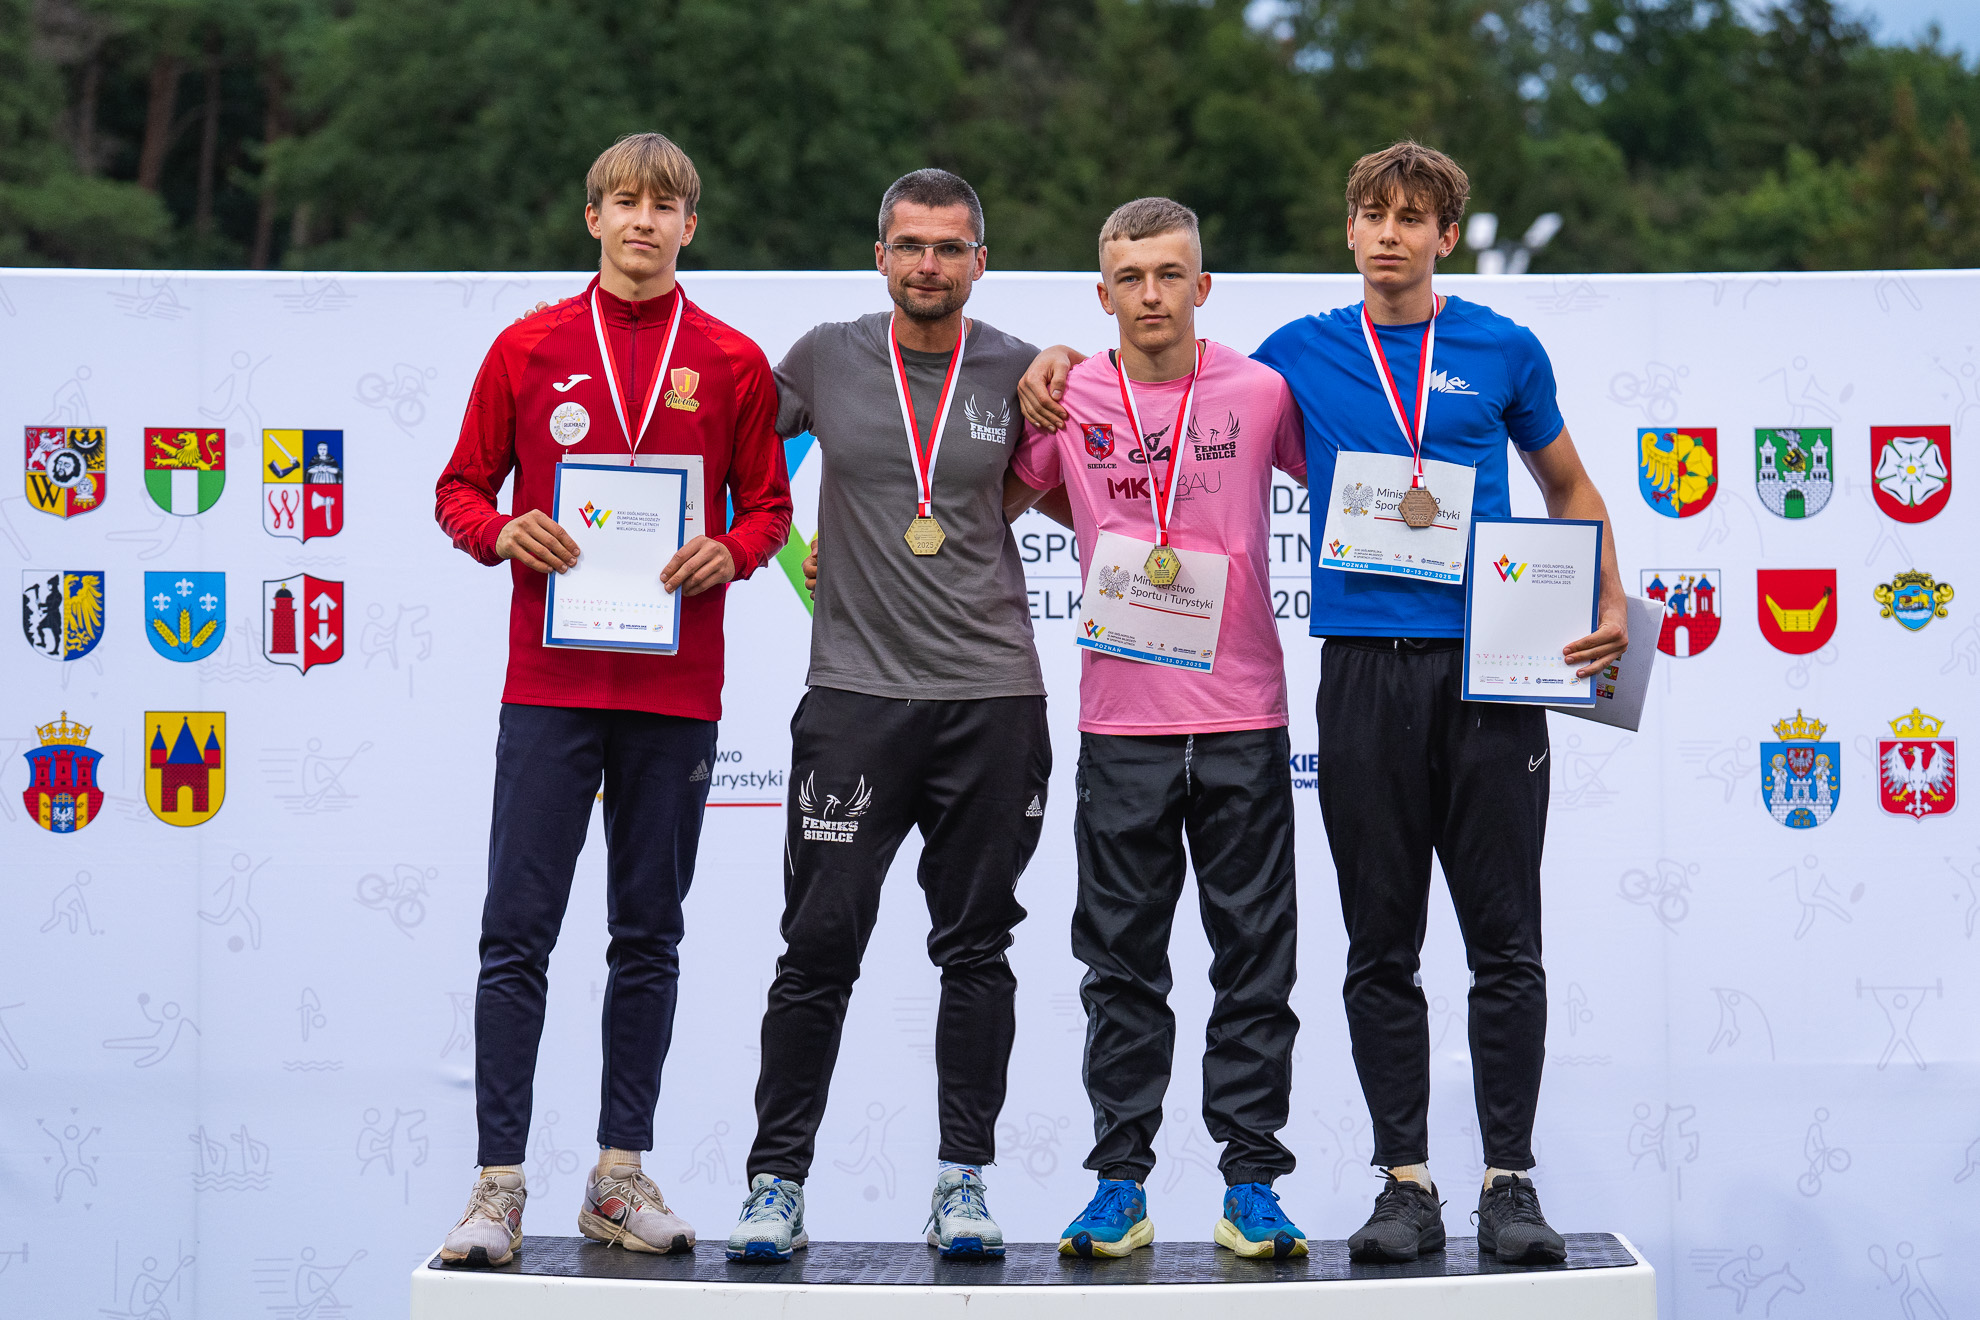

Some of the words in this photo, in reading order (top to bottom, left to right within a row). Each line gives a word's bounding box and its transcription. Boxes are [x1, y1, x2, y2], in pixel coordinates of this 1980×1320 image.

[970, 421, 1007, 437] FENIKS
[970, 431, 1006, 445] SIEDLCE
[1193, 441, 1237, 454] FENIKS
[1195, 450, 1237, 462] SIEDLCE
[1175, 471, 1221, 497] BAU
[917, 541, 934, 549] 2025
[1341, 561, 1369, 569] POZNAŃ
[1130, 585, 1162, 601] Sportu
[1170, 594, 1214, 610] Turystyki
[1094, 642, 1122, 653] POZNAŃ
[1025, 808, 1043, 817] adidas
[802, 815, 859, 832] FENIKS
[803, 829, 854, 843] SIEDLCE
